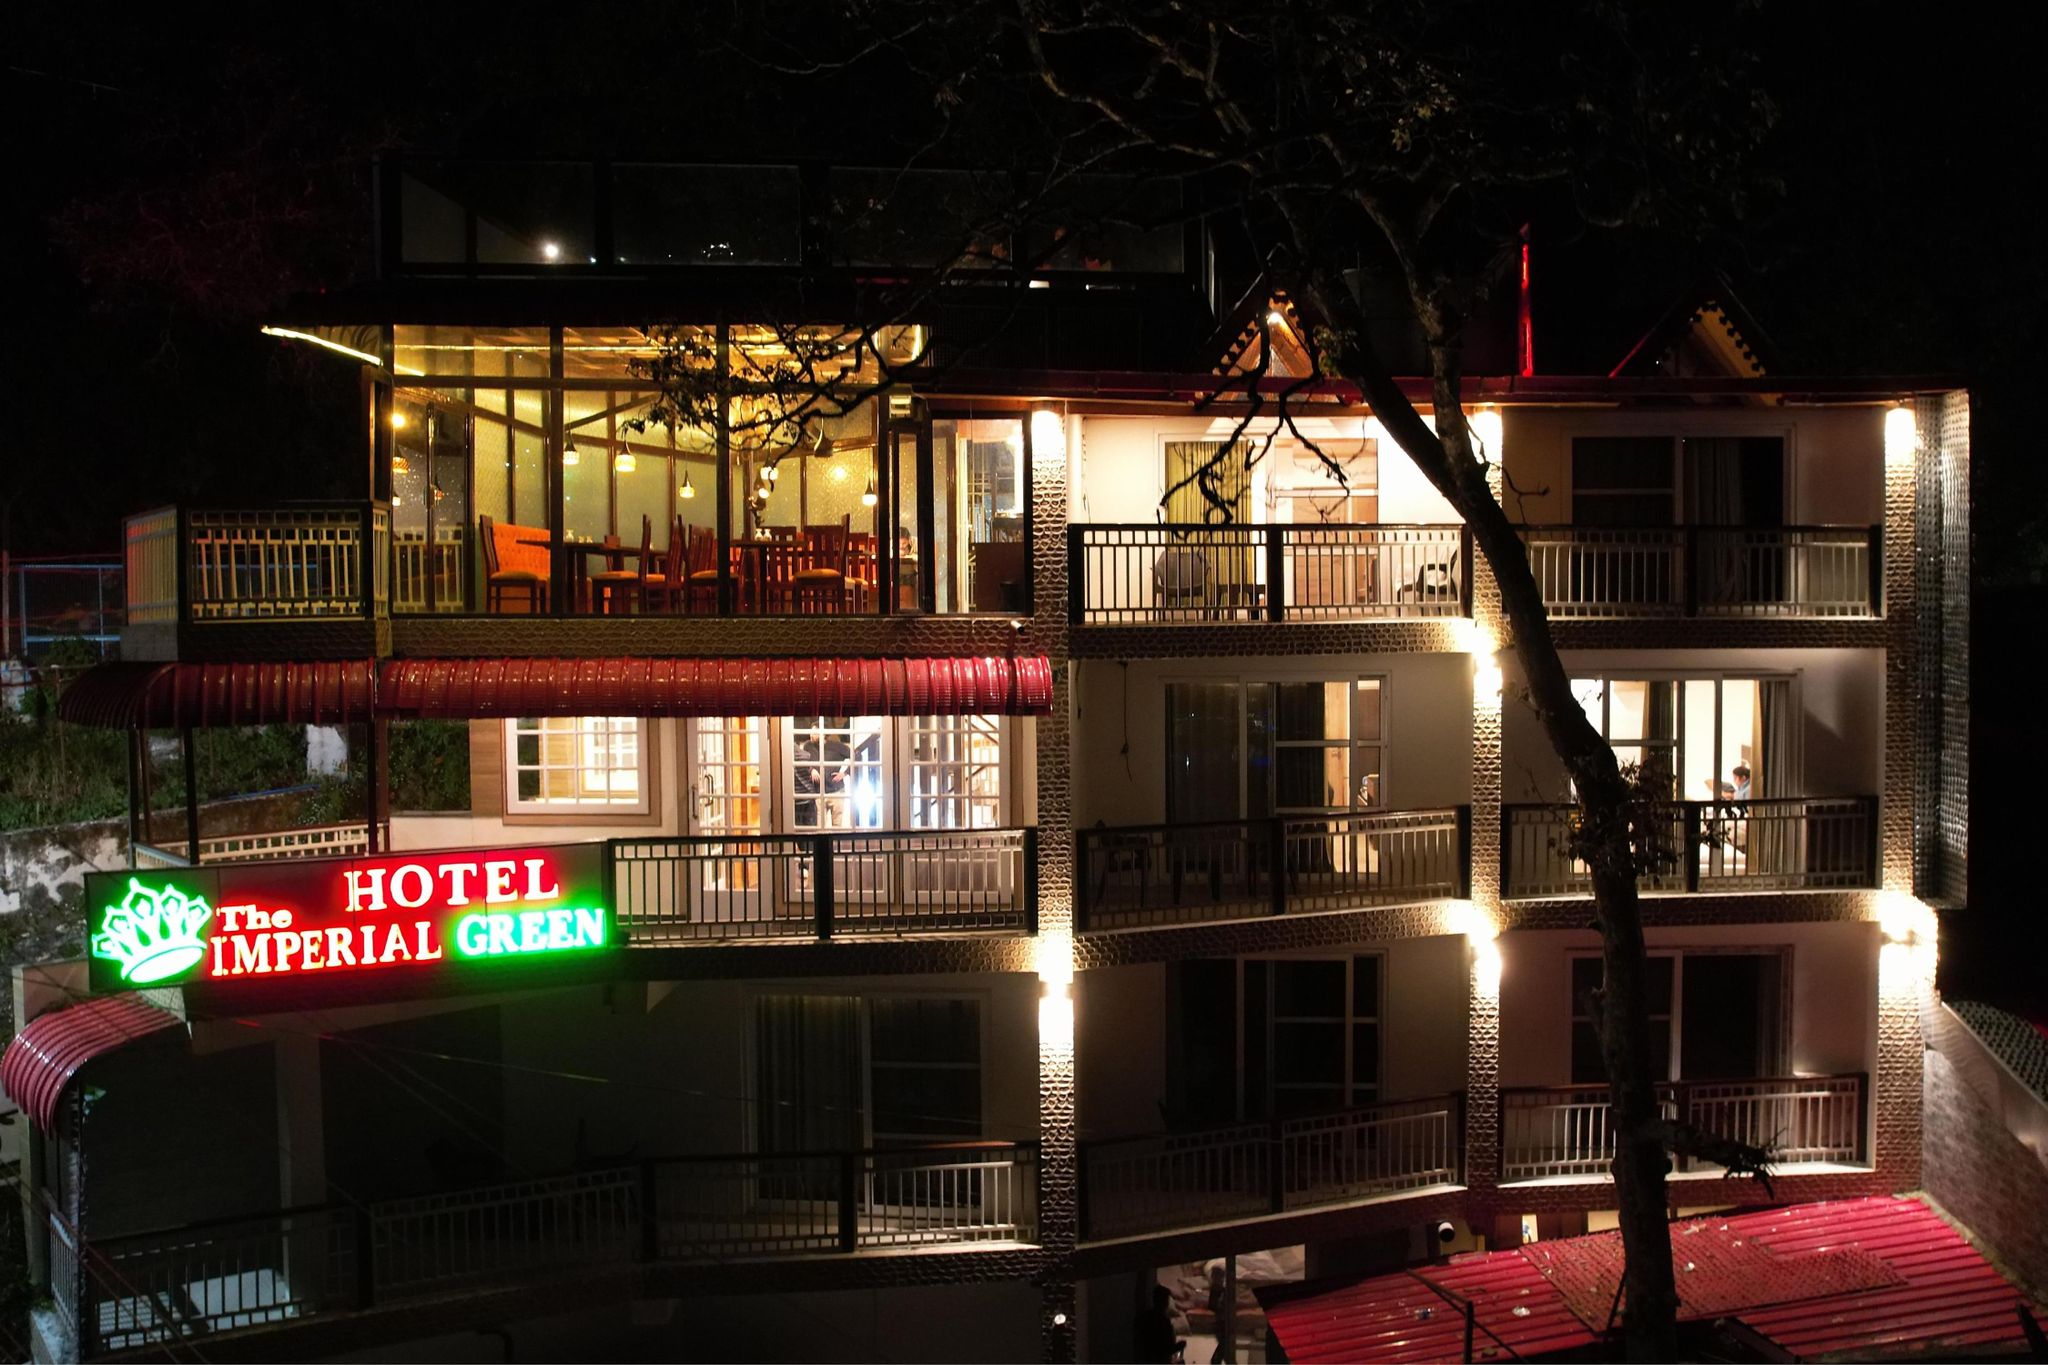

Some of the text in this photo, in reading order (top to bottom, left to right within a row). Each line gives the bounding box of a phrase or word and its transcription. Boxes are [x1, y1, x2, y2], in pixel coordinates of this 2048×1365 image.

[344, 858, 560, 912] HOTEL
[210, 908, 606, 977] IMPERIAL GREEN
[216, 904, 293, 931] The
